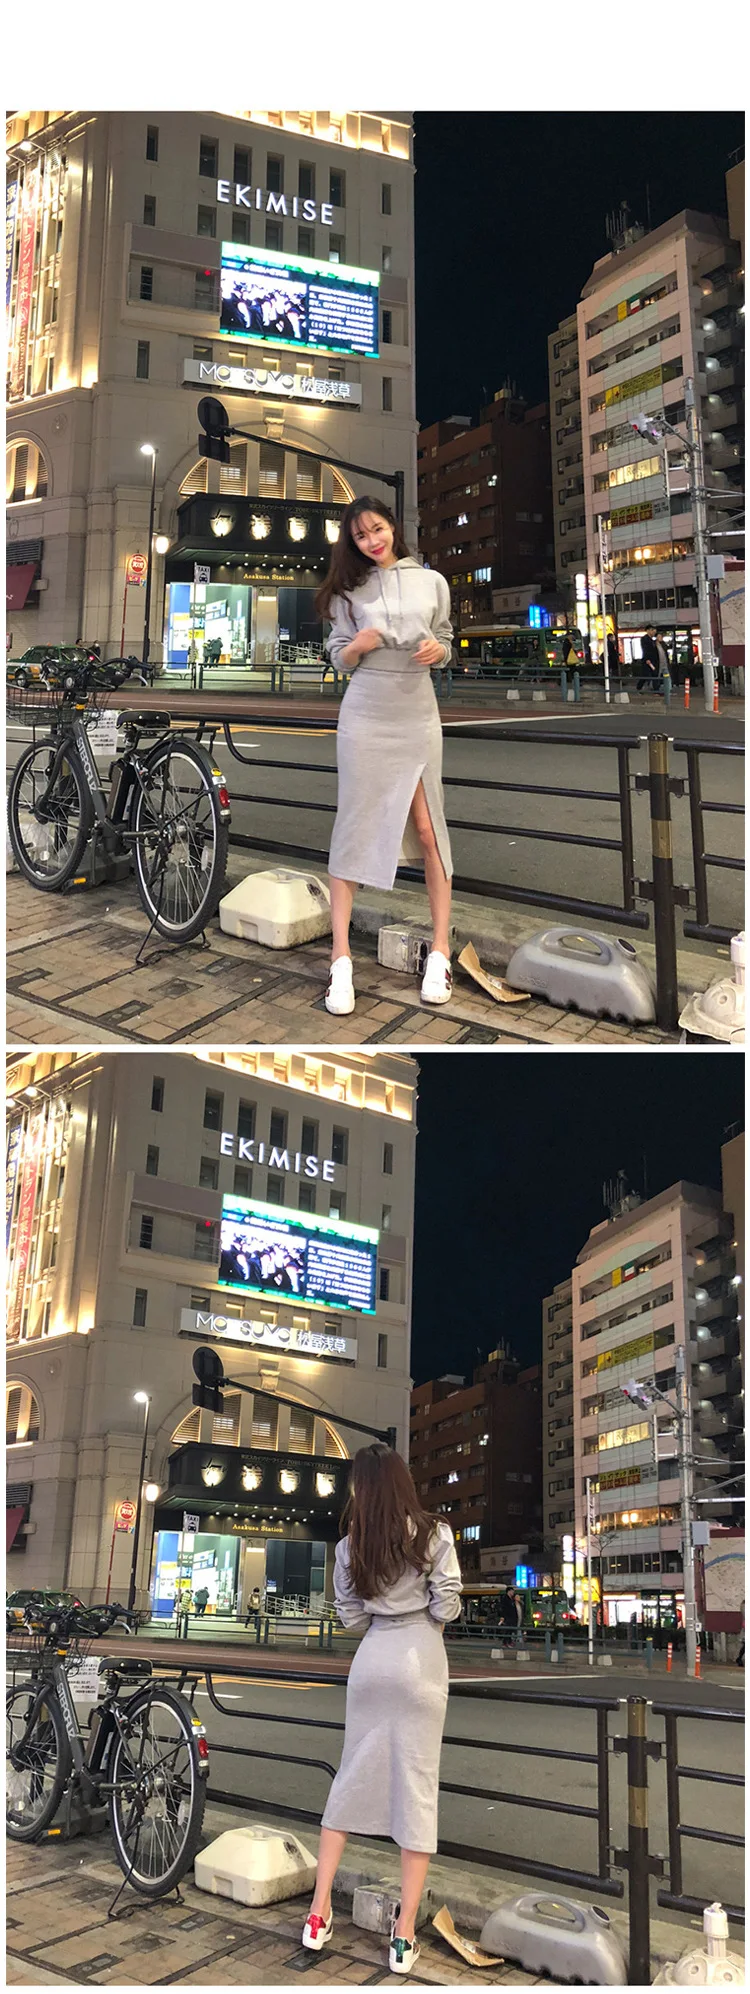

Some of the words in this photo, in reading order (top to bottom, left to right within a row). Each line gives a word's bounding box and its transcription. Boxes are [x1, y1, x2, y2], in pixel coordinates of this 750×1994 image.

[217, 179, 333, 225] EKIMISE
[199, 362, 295, 390] MASUYA
[301, 376, 350, 399] 松屋浅草
[220, 1132, 336, 1182] EKIMISE
[196, 1312, 291, 1342] MASUYA
[297, 1330, 346, 1354] 松屋浅草
[232, 1523, 259, 1531] Asakusa
[260, 1525, 284, 1533] Station
